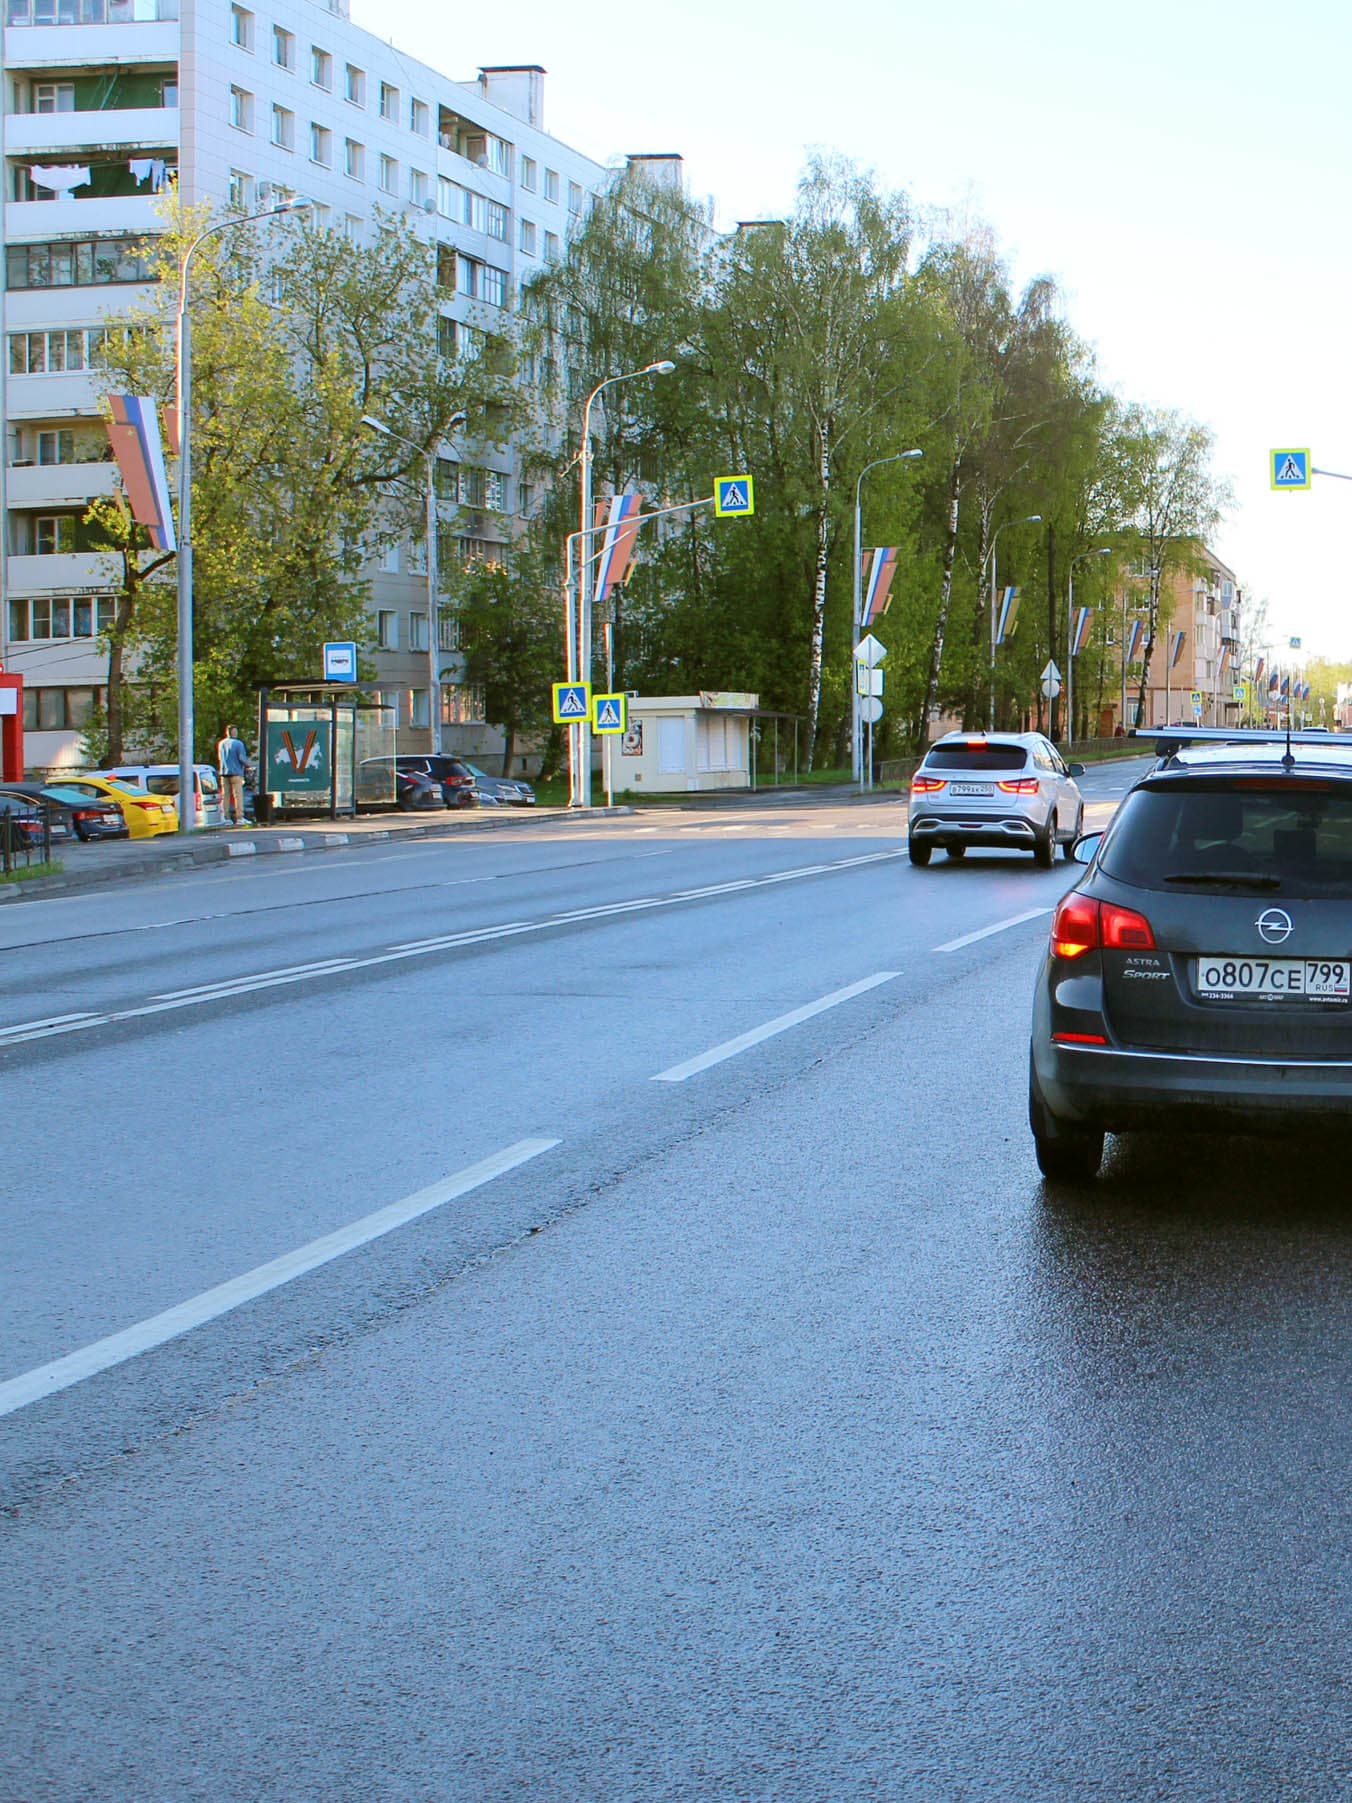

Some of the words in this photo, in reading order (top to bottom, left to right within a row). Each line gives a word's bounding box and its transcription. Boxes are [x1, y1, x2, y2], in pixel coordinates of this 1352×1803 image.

[1125, 958, 1161, 966] ASTRA
[1308, 963, 1345, 984] 799
[1315, 984, 1334, 992] RUS
